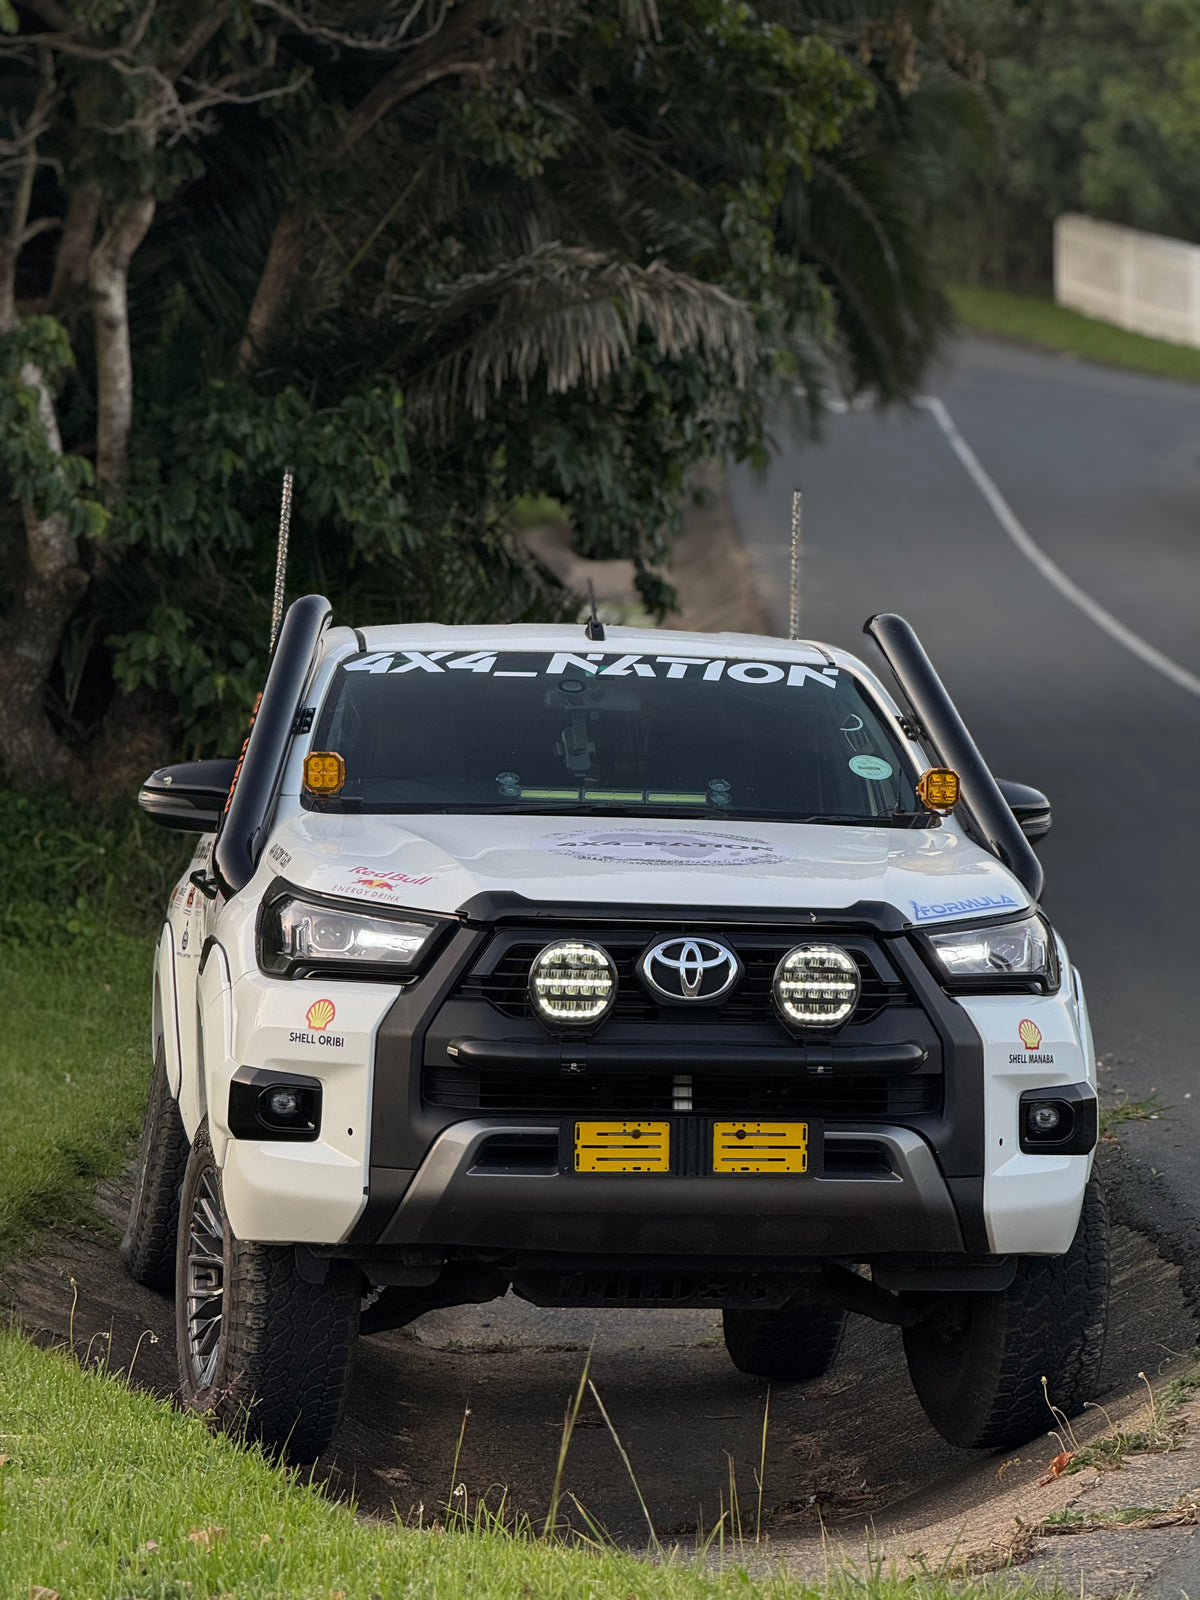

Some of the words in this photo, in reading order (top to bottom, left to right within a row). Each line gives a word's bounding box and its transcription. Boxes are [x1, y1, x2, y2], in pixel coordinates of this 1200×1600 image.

[343, 651, 837, 689] 4X4_NATION
[332, 885, 369, 896] ENERGY
[371, 891, 400, 903] DRINK
[919, 894, 1016, 916] FORMULA
[289, 1032, 316, 1044] SHELL
[318, 1035, 344, 1047] ORIBI
[1009, 1054, 1027, 1064] SHELL
[1028, 1054, 1054, 1064] MANABA
